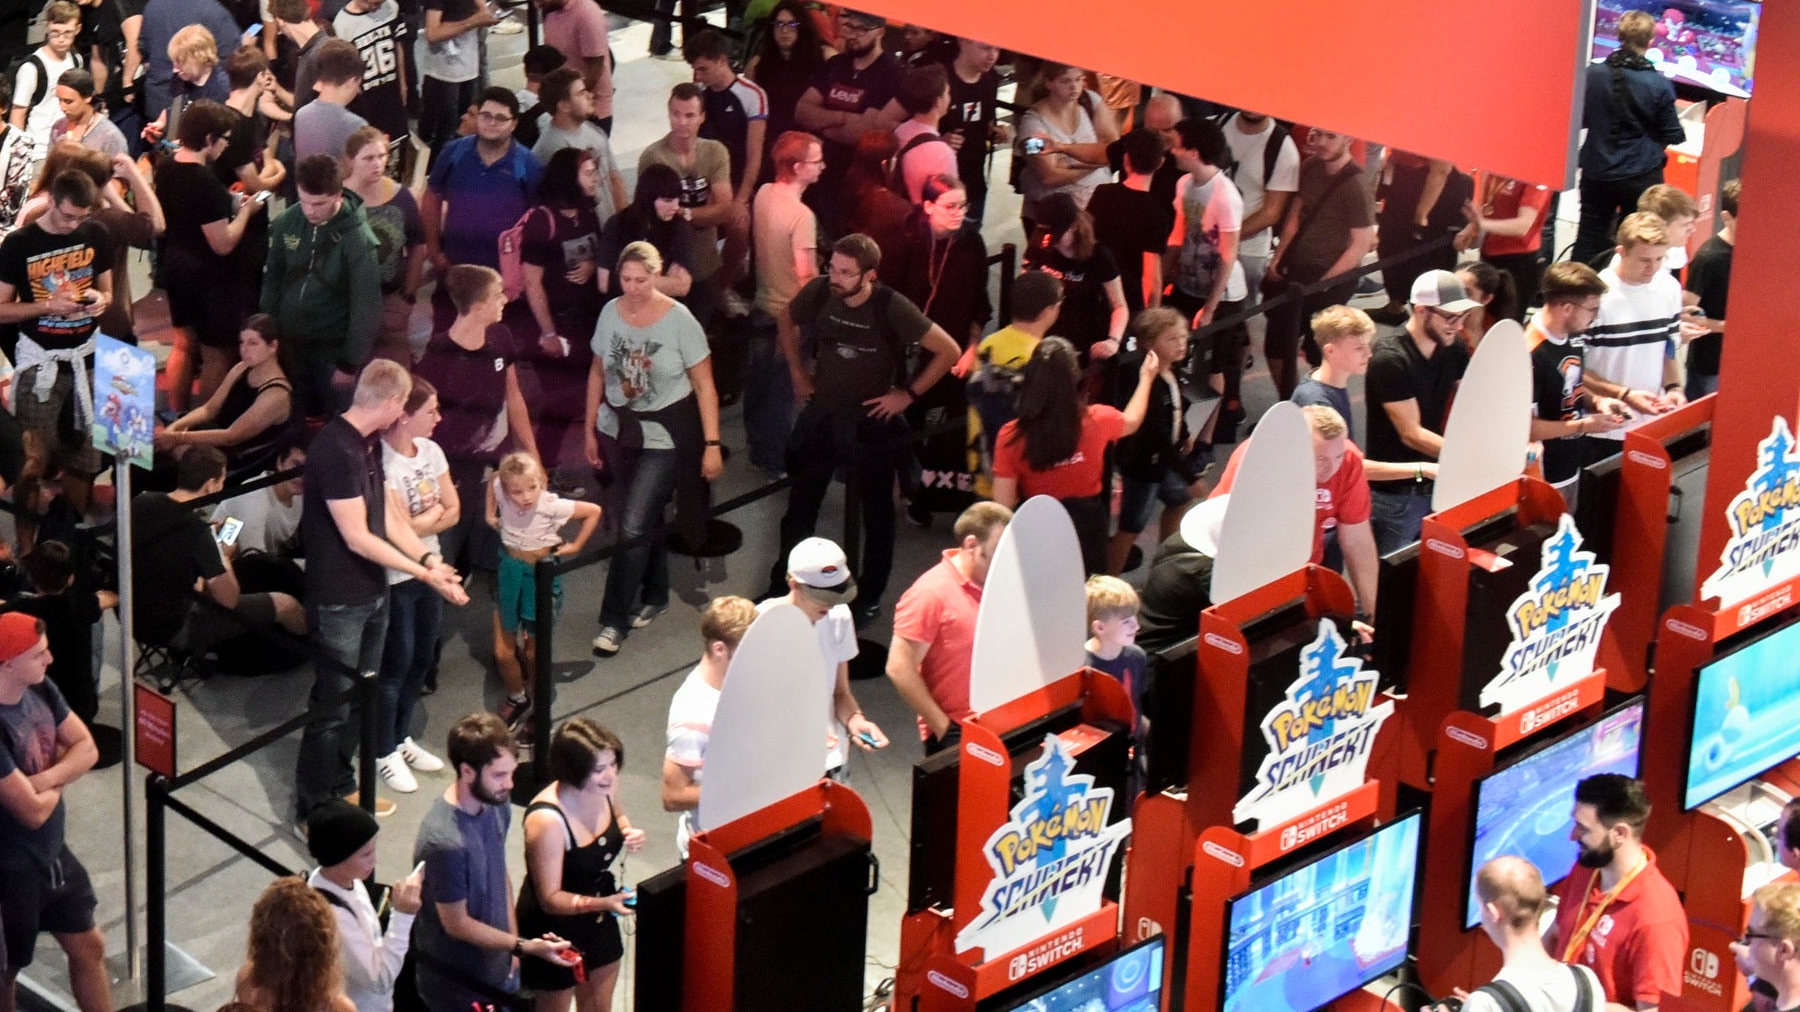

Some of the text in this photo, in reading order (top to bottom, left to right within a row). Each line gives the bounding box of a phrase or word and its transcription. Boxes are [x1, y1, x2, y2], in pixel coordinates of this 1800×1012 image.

[360, 38, 397, 80] 36
[27, 247, 95, 281] HIGHFIELD
[1733, 477, 1800, 539] Pokémo
[1533, 697, 1581, 728] SWITCH
[1296, 801, 1348, 831] NINTENDO
[1296, 811, 1350, 844] SWITCH
[1027, 927, 1084, 956] NINTENDO
[1027, 937, 1085, 973] SWITCH
